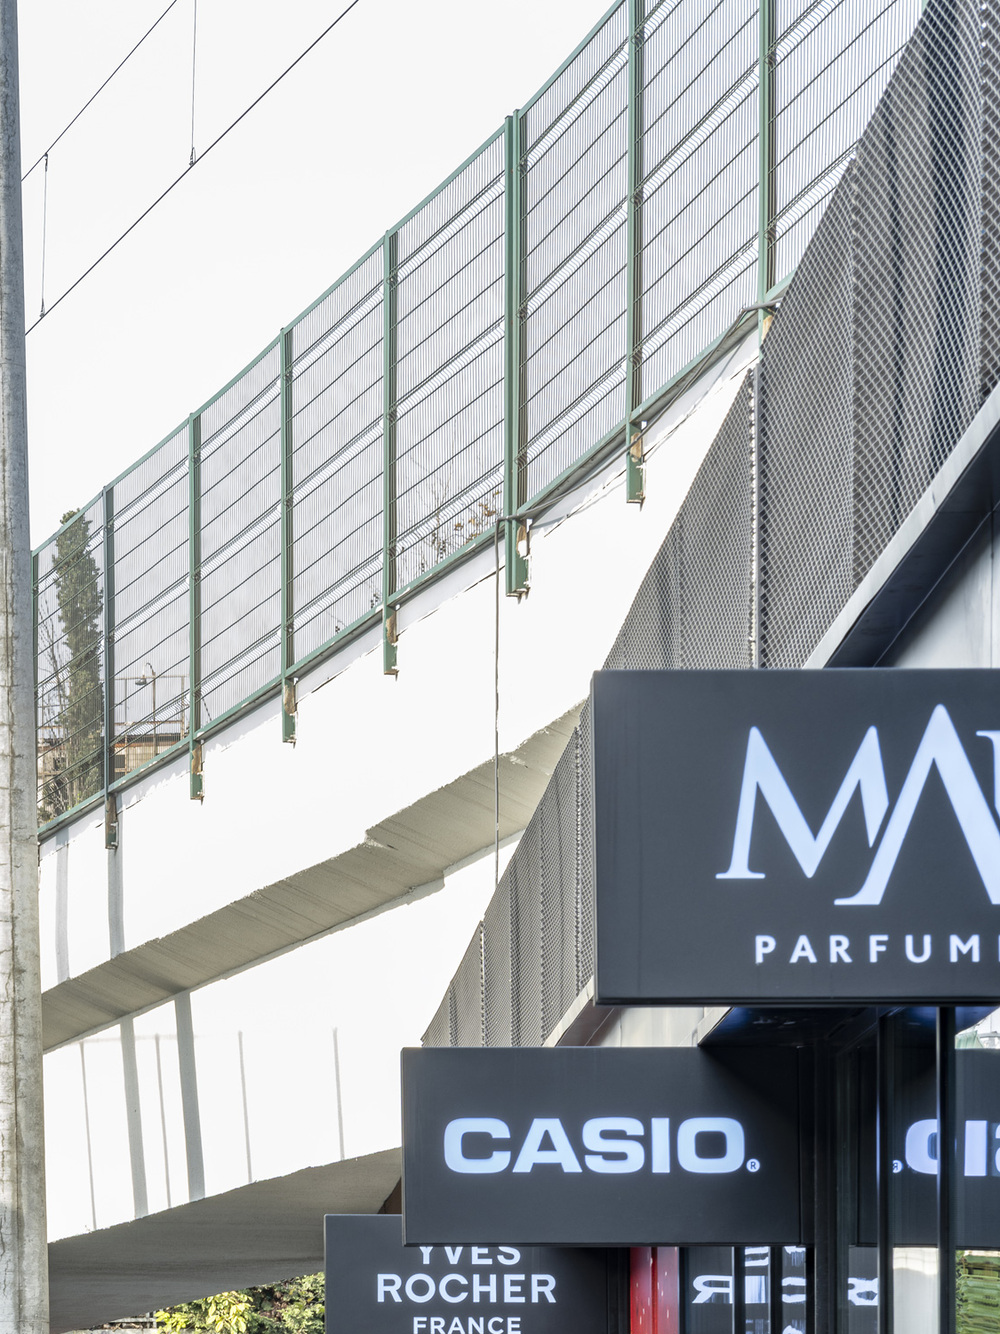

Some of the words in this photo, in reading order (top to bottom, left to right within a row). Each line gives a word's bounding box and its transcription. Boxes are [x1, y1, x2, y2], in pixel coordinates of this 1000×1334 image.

[754, 934, 1000, 963] PARFUM
[443, 1117, 746, 1174] CASIO
[377, 1273, 556, 1303] ROCHER
[413, 1316, 522, 1334] FRANCE
